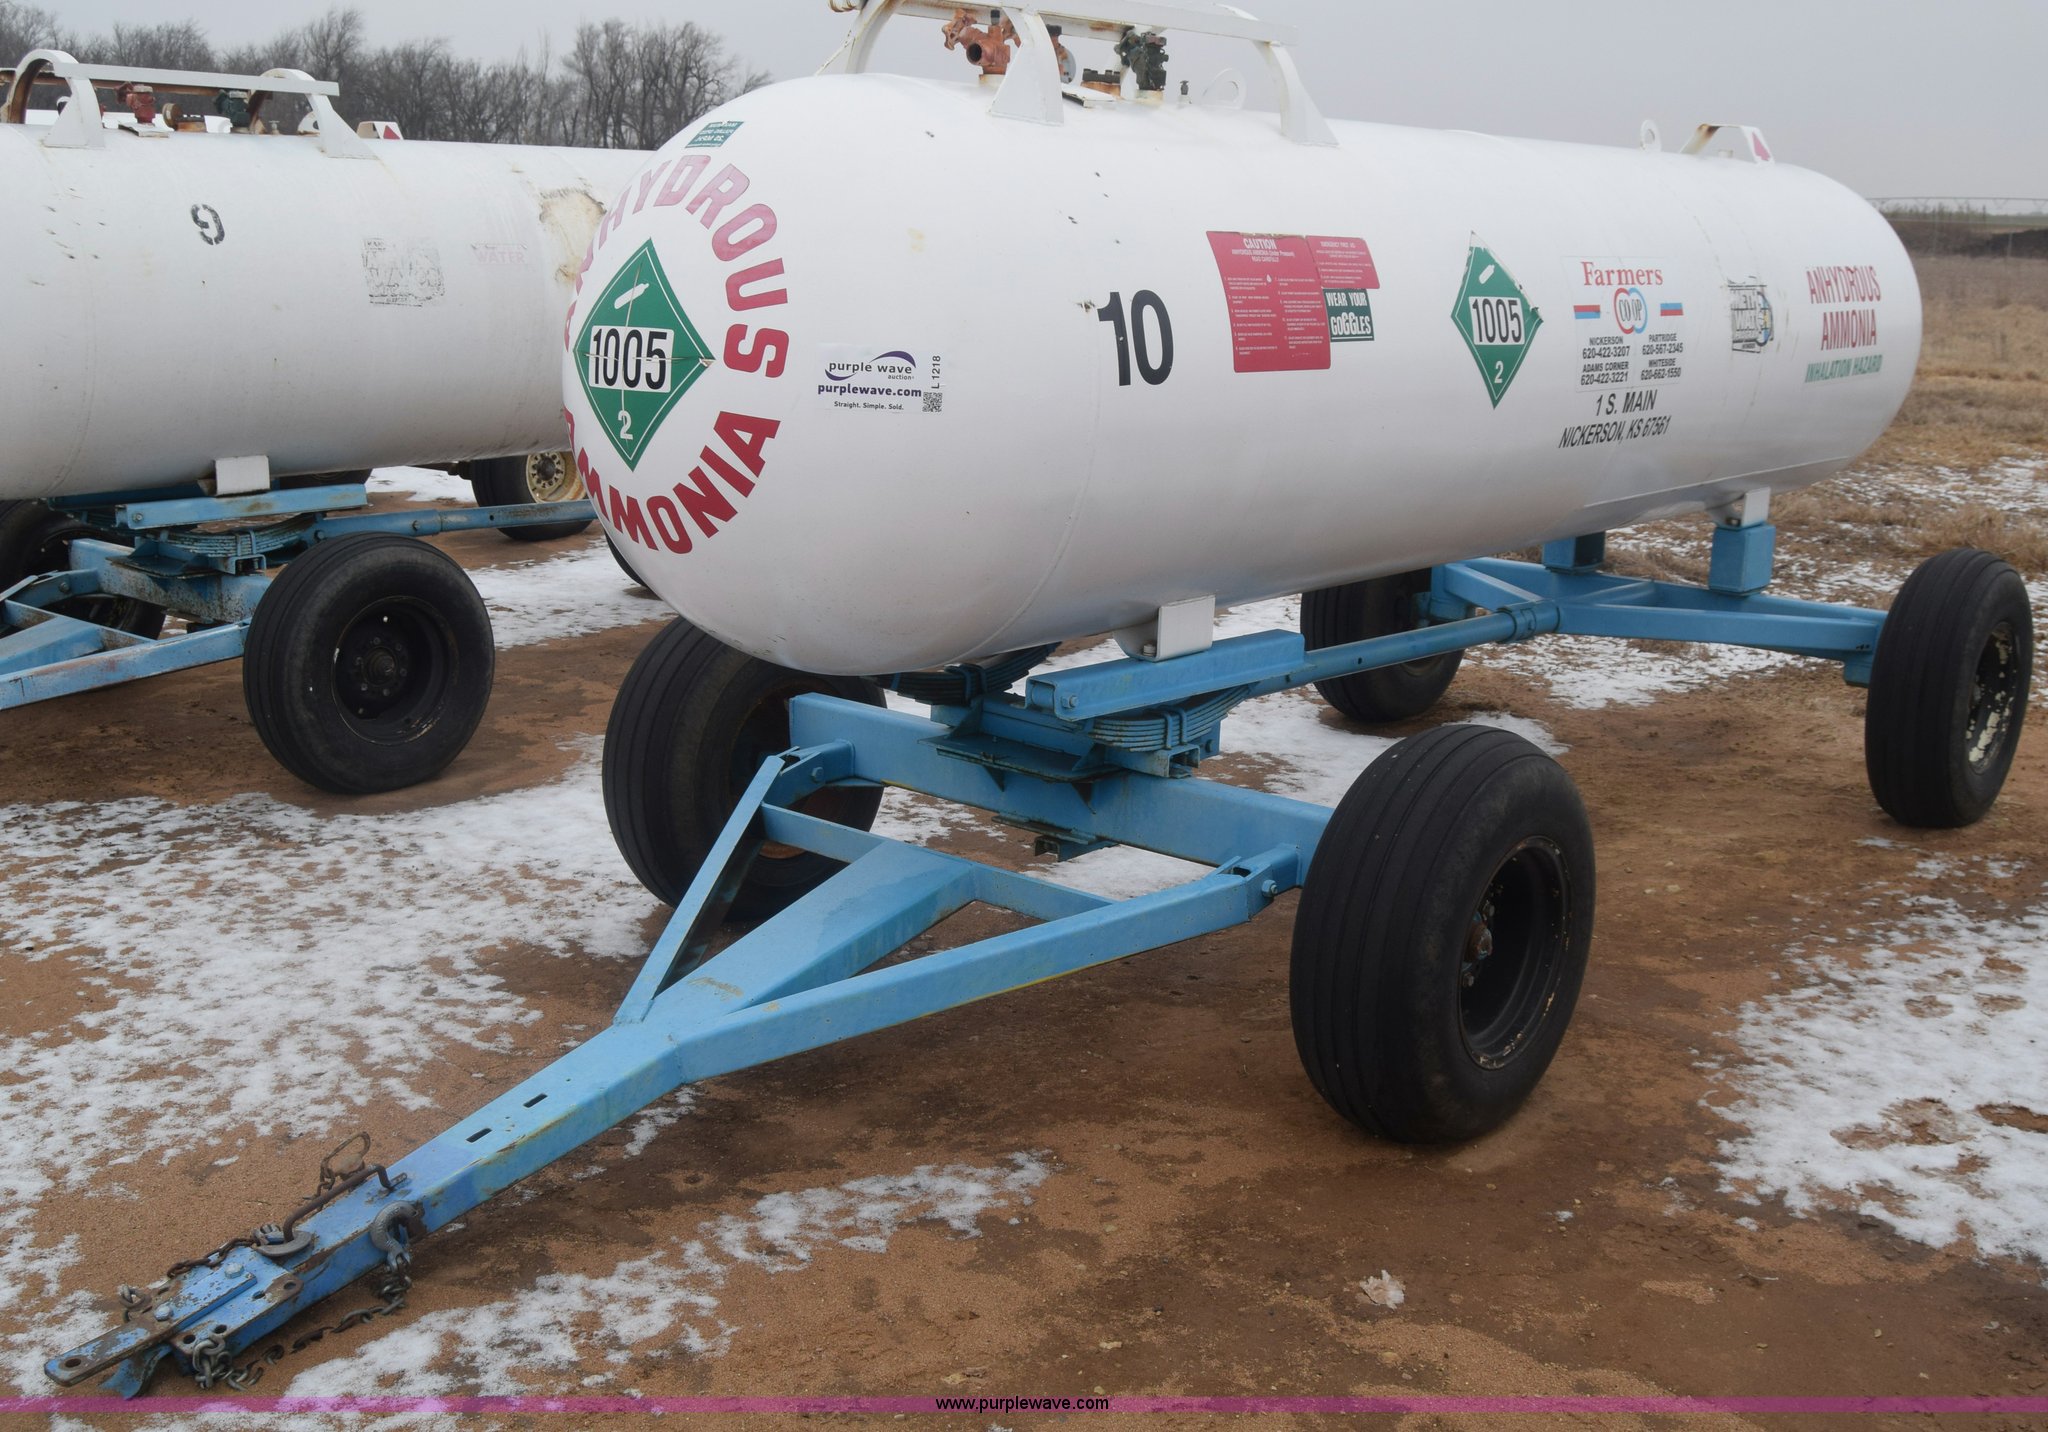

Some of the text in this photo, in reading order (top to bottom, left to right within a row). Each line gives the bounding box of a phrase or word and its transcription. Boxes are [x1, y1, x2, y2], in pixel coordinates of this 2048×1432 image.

[190, 203, 225, 245] 9
[1243, 238, 1277, 250] CAUTION
[475, 251, 525, 265] WATER
[564, 155, 789, 378] ANHYDROUS
[1580, 261, 1664, 286] Farmers
[1806, 265, 1881, 304] ANHYDROUS
[1325, 292, 1347, 307] WEAR
[1348, 292, 1368, 307] YOUR
[1330, 312, 1371, 336] GOGGLES
[1472, 298, 1522, 343] 1005
[1820, 309, 1877, 350] AMMONIA
[1097, 289, 1174, 386] 10
[1589, 336, 1624, 346] NICKERSON
[1649, 333, 1677, 343] PARTRIDGE
[593, 328, 668, 390] 1005
[1582, 346, 1630, 360] 620-422-3207
[1648, 358, 1676, 368] WHITESIDE
[829, 362, 912, 374] purple wave
[931, 355, 941, 380] 1218
[1494, 361, 1504, 384] 2
[1581, 371, 1629, 386] 620-422-3221
[1583, 361, 1629, 373] ADAMS CORNER
[1805, 354, 1883, 383] INHALATION HAZARD
[818, 383, 922, 397] purplewave.com
[834, 401, 904, 411] Straight. Simple. Sold.
[1596, 389, 1658, 416] 1 S. MAIN
[617, 410, 634, 440] 2
[1558, 415, 1672, 448] NICKERSON, KS 67561
